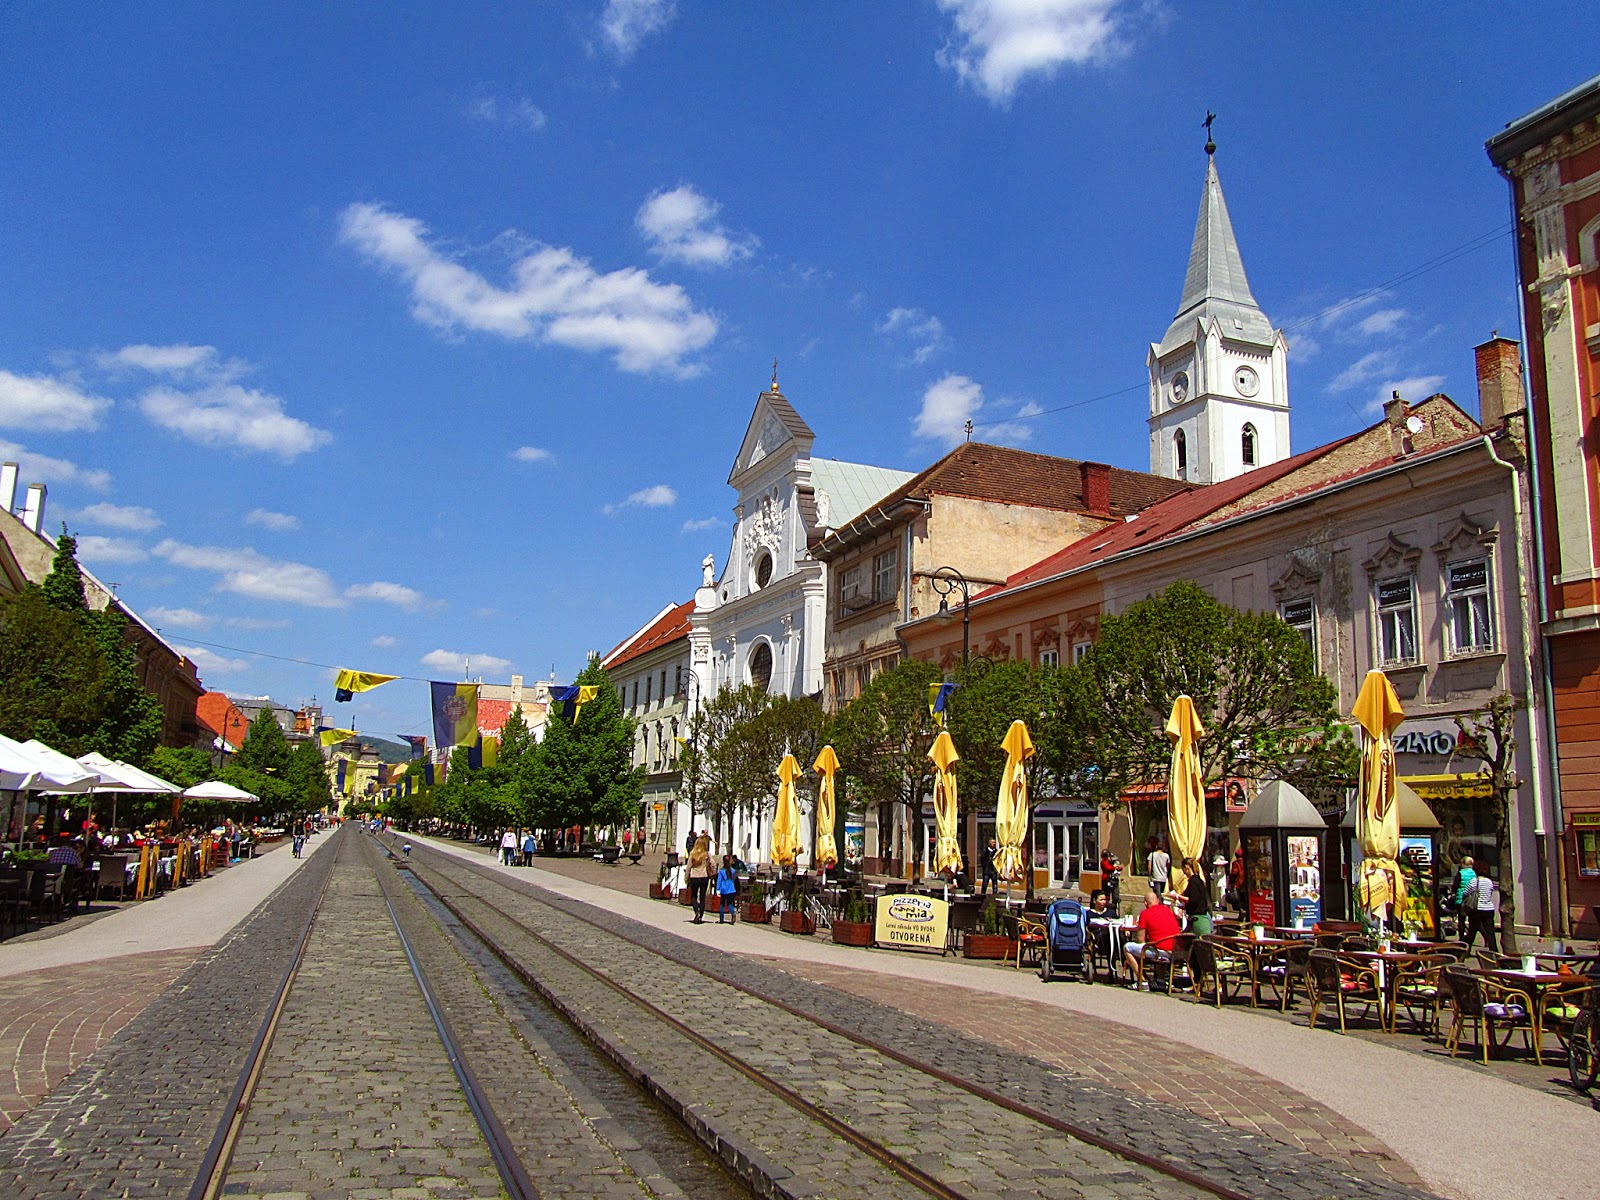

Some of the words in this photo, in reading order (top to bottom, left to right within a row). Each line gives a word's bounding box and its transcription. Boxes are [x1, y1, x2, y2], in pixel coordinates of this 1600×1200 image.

[1393, 730, 1456, 755] ZLATO
[893, 896, 931, 909] pizzeria
[906, 908, 927, 918] mia
